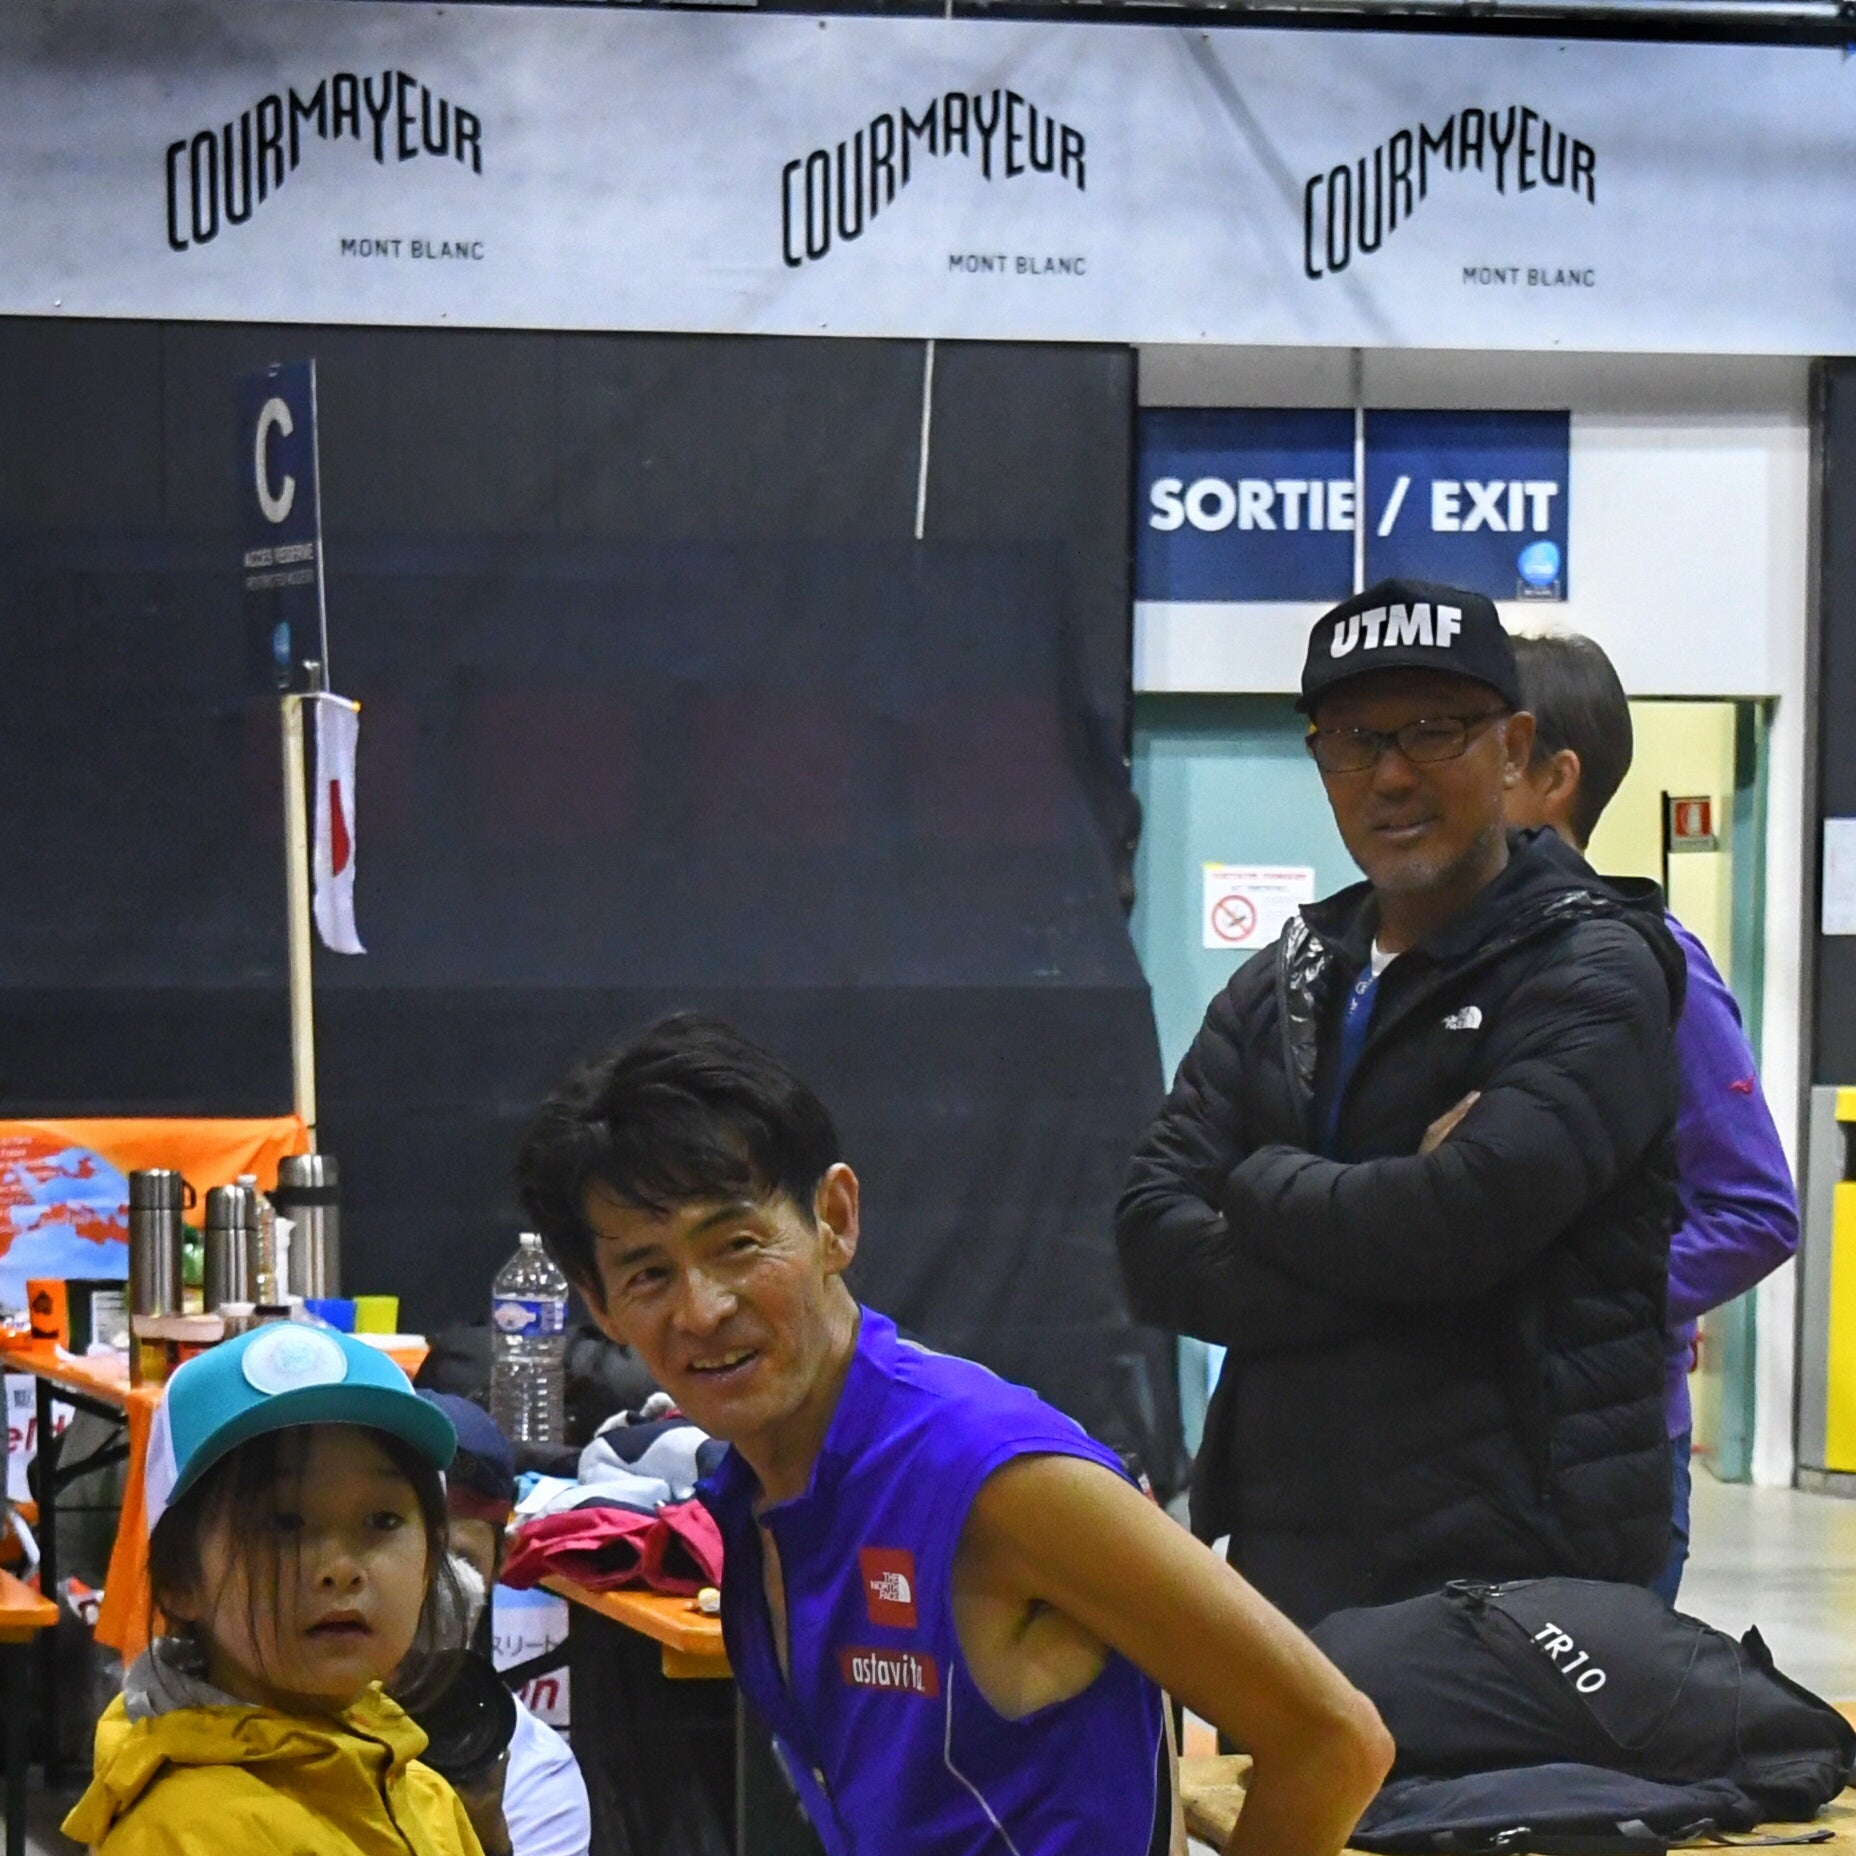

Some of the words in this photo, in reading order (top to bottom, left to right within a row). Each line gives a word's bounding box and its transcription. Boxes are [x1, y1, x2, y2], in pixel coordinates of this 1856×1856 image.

[164, 70, 482, 253] COURMAYEUR
[779, 88, 1088, 269] COURMAYEUR
[1301, 106, 1598, 281] COURMAYEUR
[341, 237, 402, 260] MONT
[411, 238, 485, 262] BLANC
[948, 254, 1009, 275] MONT
[1016, 255, 1087, 277] BLANC
[1461, 265, 1522, 288] MONT
[1528, 266, 1597, 289] BLANC
[255, 398, 295, 523] C
[1149, 477, 1356, 532] SORTIE
[1431, 480, 1558, 532] EXIT
[1330, 602, 1462, 658] UTMF
[1533, 1622, 1607, 1696] TR10
